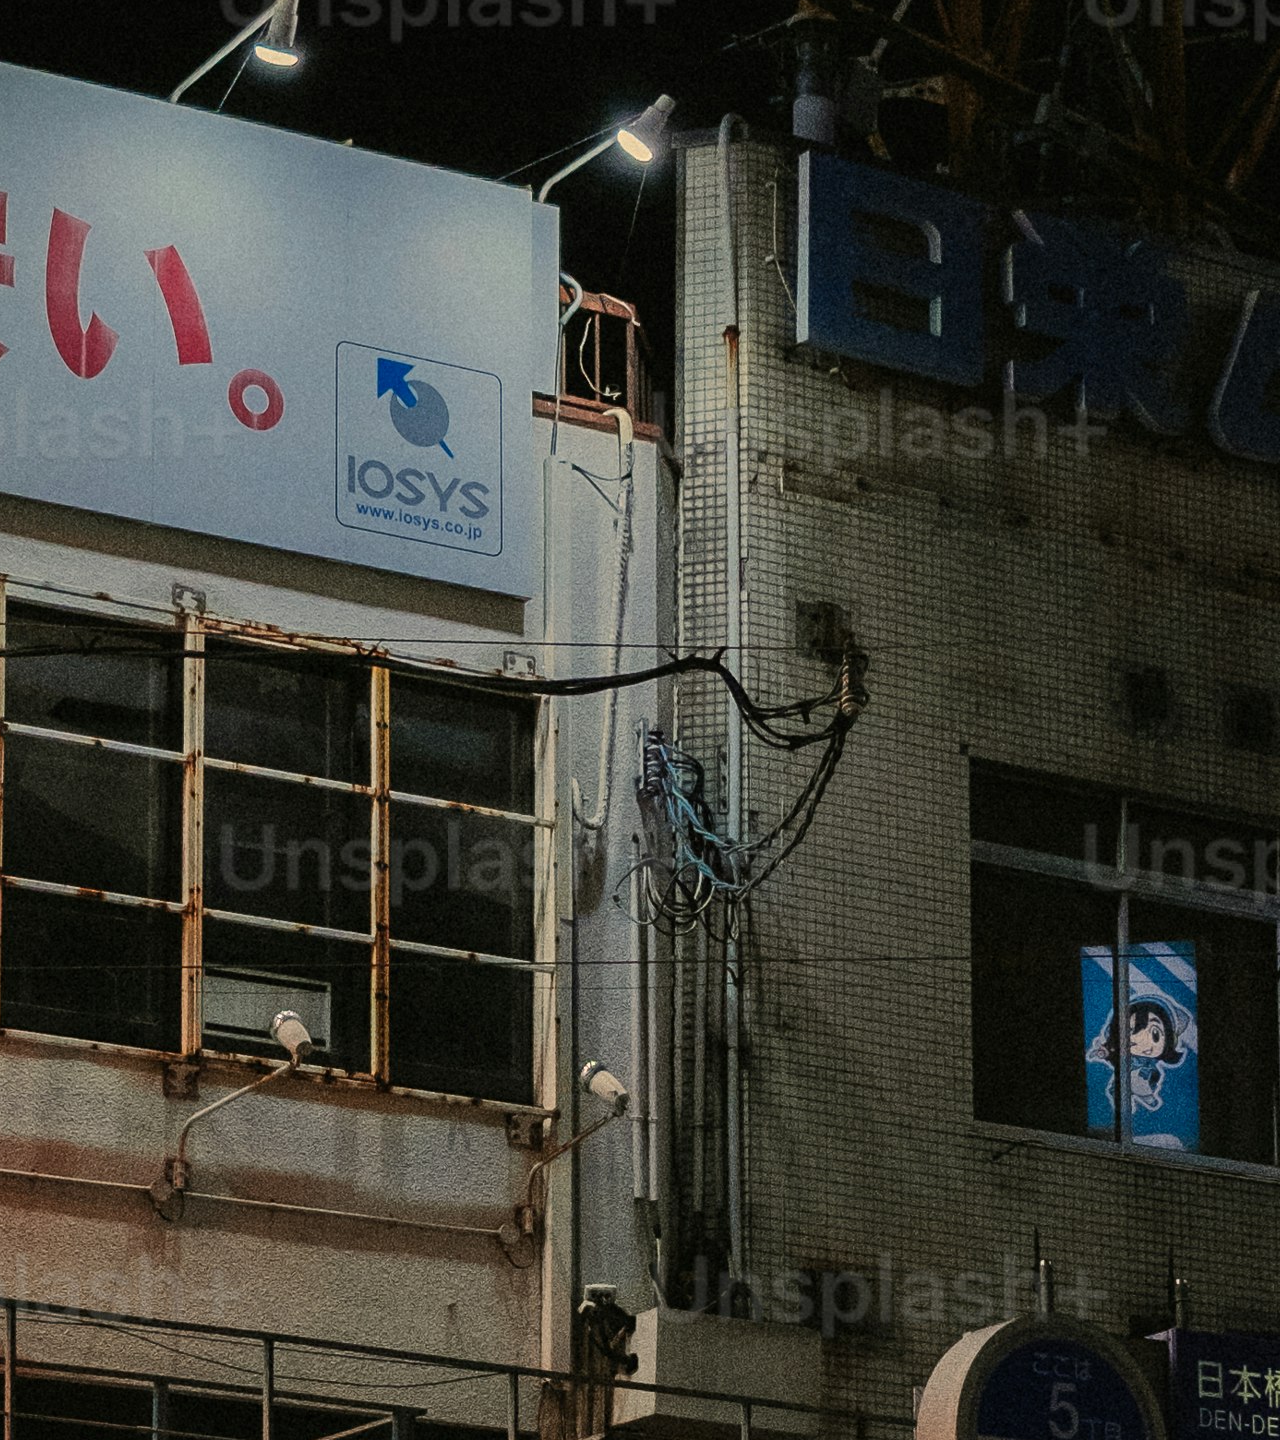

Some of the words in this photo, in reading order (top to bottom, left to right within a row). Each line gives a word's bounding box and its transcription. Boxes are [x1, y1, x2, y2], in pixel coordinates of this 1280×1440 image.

[347, 454, 489, 519] IOSYS
[355, 500, 483, 540] www.iosys.co.jp
[1032, 1350, 1091, 1381] ここは
